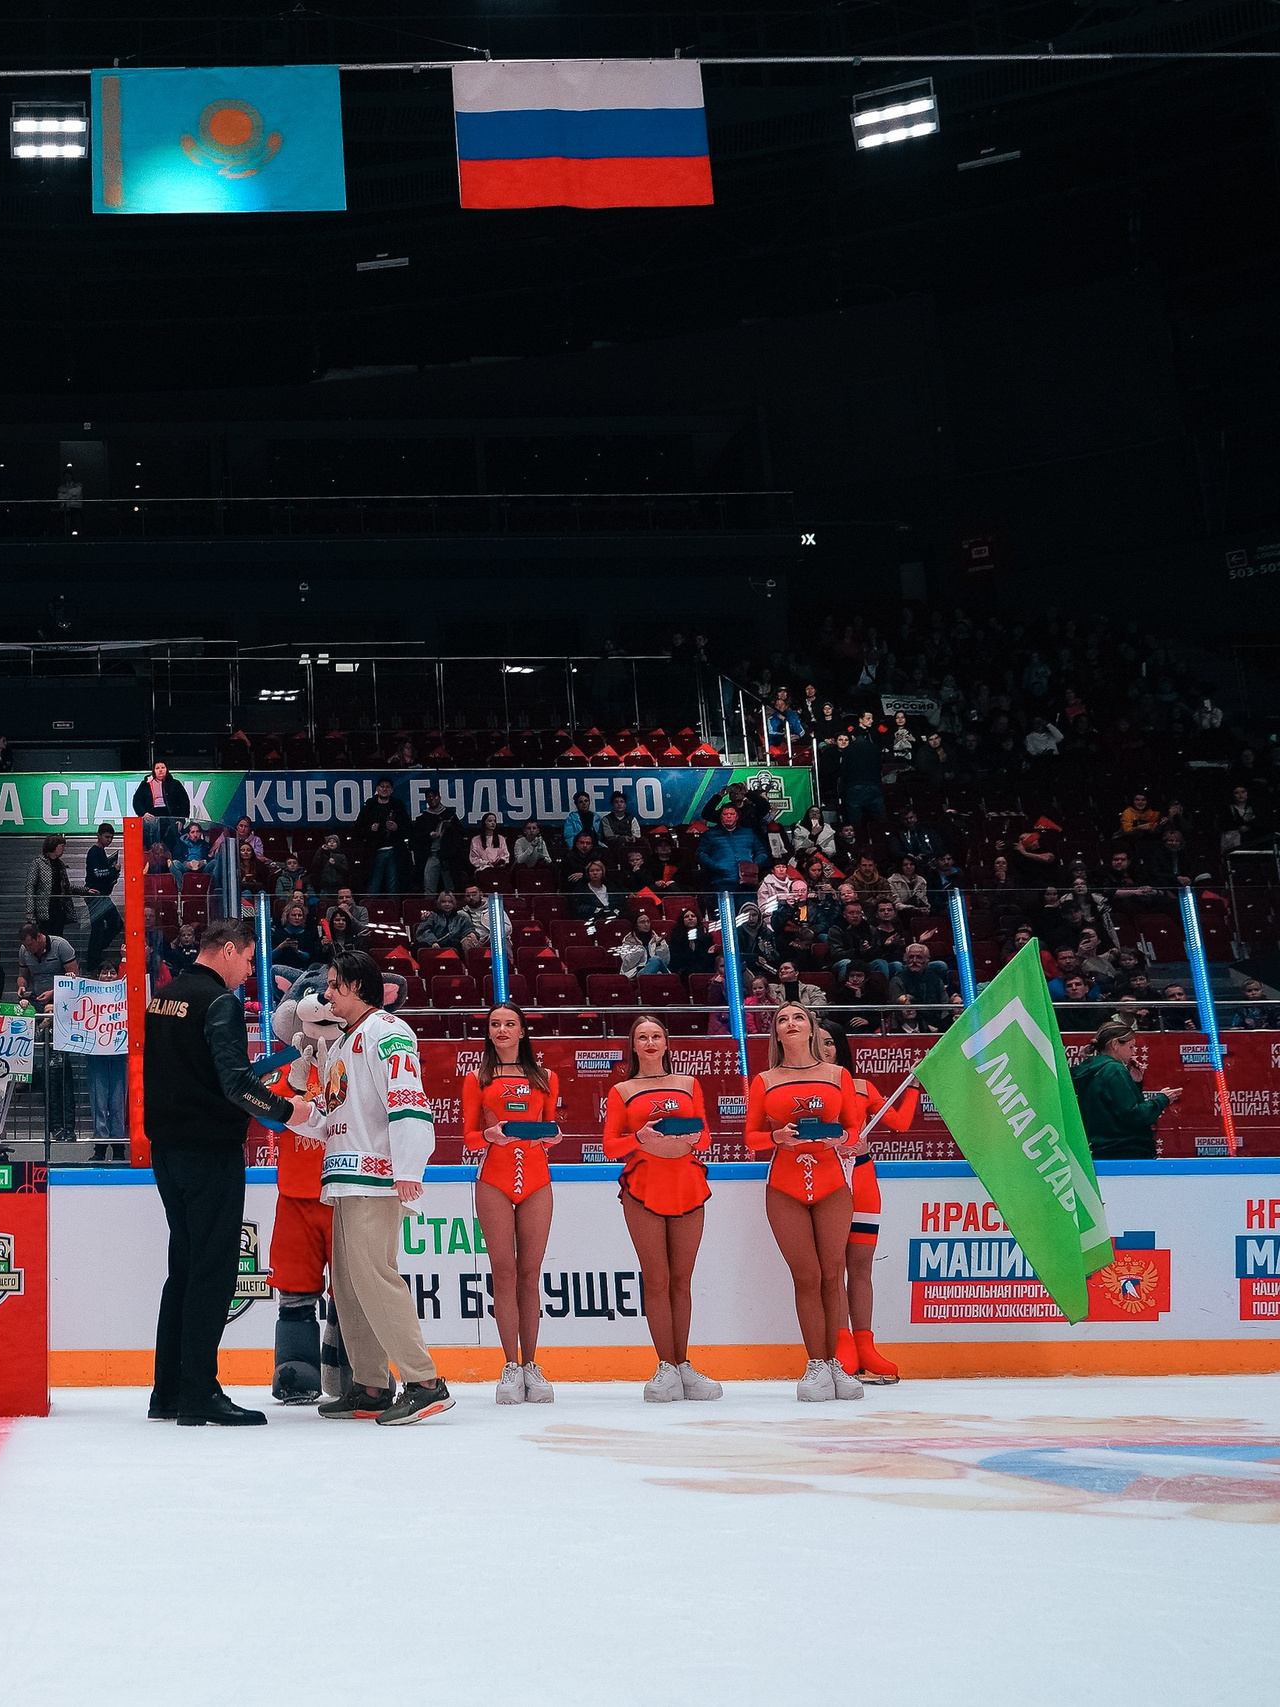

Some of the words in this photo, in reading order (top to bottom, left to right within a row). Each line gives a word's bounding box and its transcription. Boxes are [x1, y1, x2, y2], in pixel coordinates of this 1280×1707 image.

[885, 700, 934, 711] РОССИЯ
[578, 1051, 610, 1060] КРАСНАЯ
[856, 1048, 911, 1060] КРАСНАЯ
[577, 1061, 611, 1070] МАШИНА
[856, 1060, 912, 1074] МАШИНА
[975, 1053, 1037, 1138] ЛИГА
[720, 1106, 747, 1115] МАШИН
[868, 1141, 923, 1153] КРАСНАЯ
[924, 1284, 1011, 1301] НАЦИОНАЛЬНАЯ
[923, 1304, 995, 1321] ПОДГОТОВКИ
